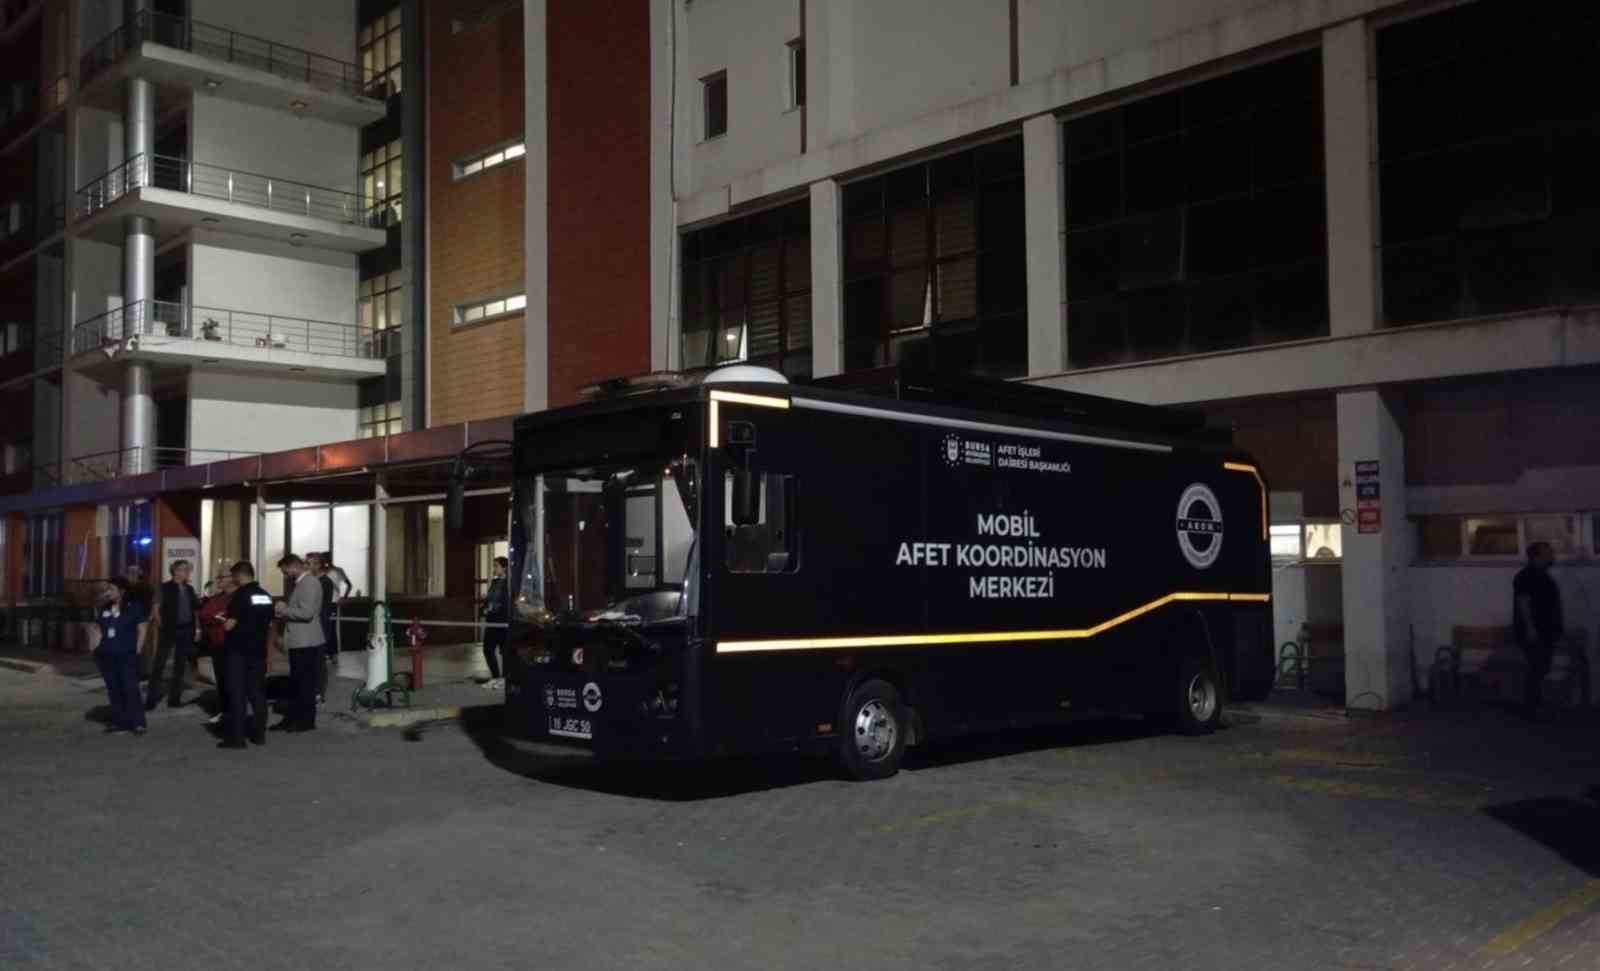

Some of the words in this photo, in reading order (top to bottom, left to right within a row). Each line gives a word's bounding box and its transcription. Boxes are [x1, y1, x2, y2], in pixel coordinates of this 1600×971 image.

[998, 444, 1017, 455] AFET
[1018, 445, 1041, 458] İŞLERİ
[998, 456, 1028, 469] DAİRESİ
[1029, 460, 1071, 473] BAŞKANLIĞI
[977, 509, 1040, 537] MOBİL
[896, 542, 951, 566] AFET
[956, 540, 1106, 568] KOORDİNASYON
[969, 571, 1054, 598] MERKEZİ
